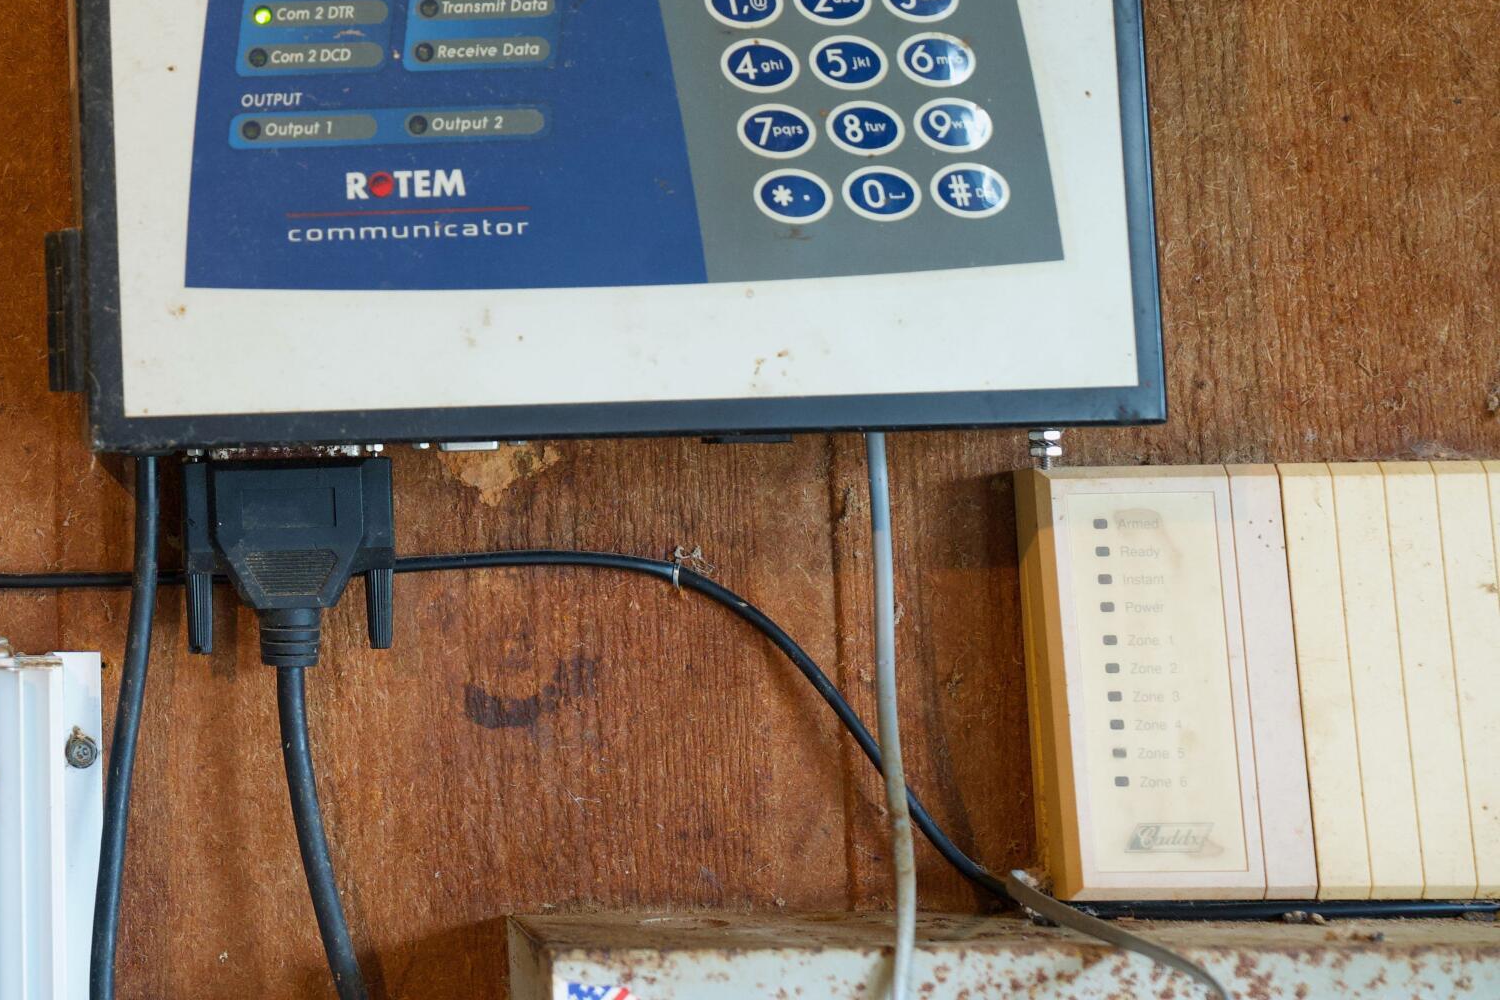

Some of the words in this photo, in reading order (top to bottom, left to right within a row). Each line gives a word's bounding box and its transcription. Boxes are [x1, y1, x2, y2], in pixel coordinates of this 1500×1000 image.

[276, 6, 312, 21] Com
[315, 6, 324, 20] 2
[328, 5, 355, 20] DTR
[441, 0, 506, 15] Transmit
[270, 50, 304, 64] Com
[307, 49, 316, 62] 2
[320, 47, 352, 62] DCD
[437, 43, 500, 59] Receive
[502, 42, 540, 57] Data
[241, 92, 303, 107] OUTPUT
[265, 121, 322, 140] Output
[326, 120, 333, 134] 1
[431, 116, 488, 135] Output
[492, 116, 503, 130] 2
[346, 168, 466, 200] ROTEM
[288, 219, 530, 242] communicator
[1116, 517, 1160, 530] Armed
[1120, 545, 1160, 560] Ready
[1122, 573, 1165, 585] Instant
[1125, 601, 1164, 613] Power
[1127, 634, 1160, 647] Zone
[1130, 662, 1162, 674] Zone
[1132, 690, 1164, 703] Zone
[1134, 719, 1167, 731] Zone
[1137, 747, 1170, 760] Zone
[1139, 776, 1172, 788] Zone
